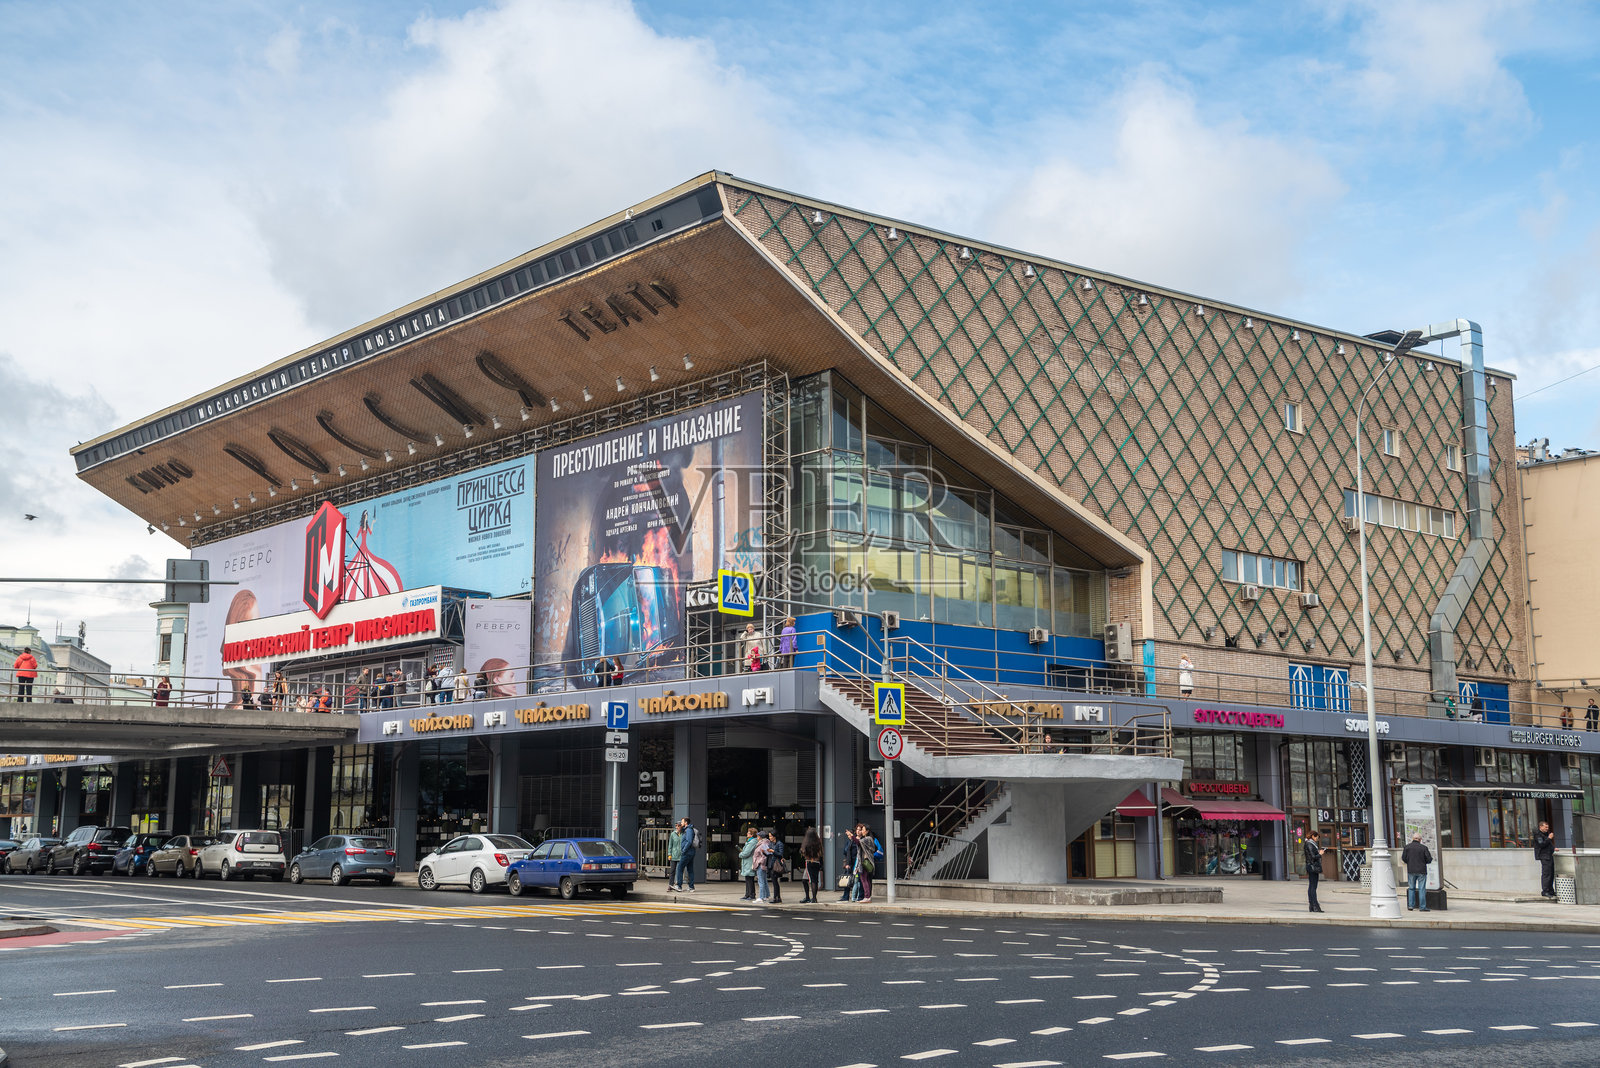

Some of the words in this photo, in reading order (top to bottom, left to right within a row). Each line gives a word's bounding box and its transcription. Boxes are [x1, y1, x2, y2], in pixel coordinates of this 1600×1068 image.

[198, 373, 287, 419] МОСКОВСКИЙ
[300, 348, 349, 378] ТЕАТР
[365, 308, 445, 352] МЮЗИКЛА
[552, 431, 644, 479] ПРЕСТУПЛЕНИЕ
[649, 428, 657, 454] И
[663, 405, 742, 452] НАКАЗАНИЕ
[457, 467, 525, 507] ПРИНЦЕССА
[468, 499, 511, 533] ЦИРКА
[606, 504, 629, 520] АНДРЕЙ
[631, 492, 679, 515] КОНЧАЛОВСКИЙ
[224, 549, 272, 574] РЕВЕРС
[223, 624, 311, 662] МОСКОВСКИЙ
[311, 622, 354, 649] ТЕАТР
[354, 608, 436, 643] МЮЗИКЛА
[475, 623, 521, 631] РЕВЕРС
[409, 712, 474, 732] ЧАЙХОНА
[515, 701, 590, 724] ЧАЙХОНА
[638, 690, 729, 714] ЧАЙХОНА
[1526, 731, 1553, 745] BURGER
